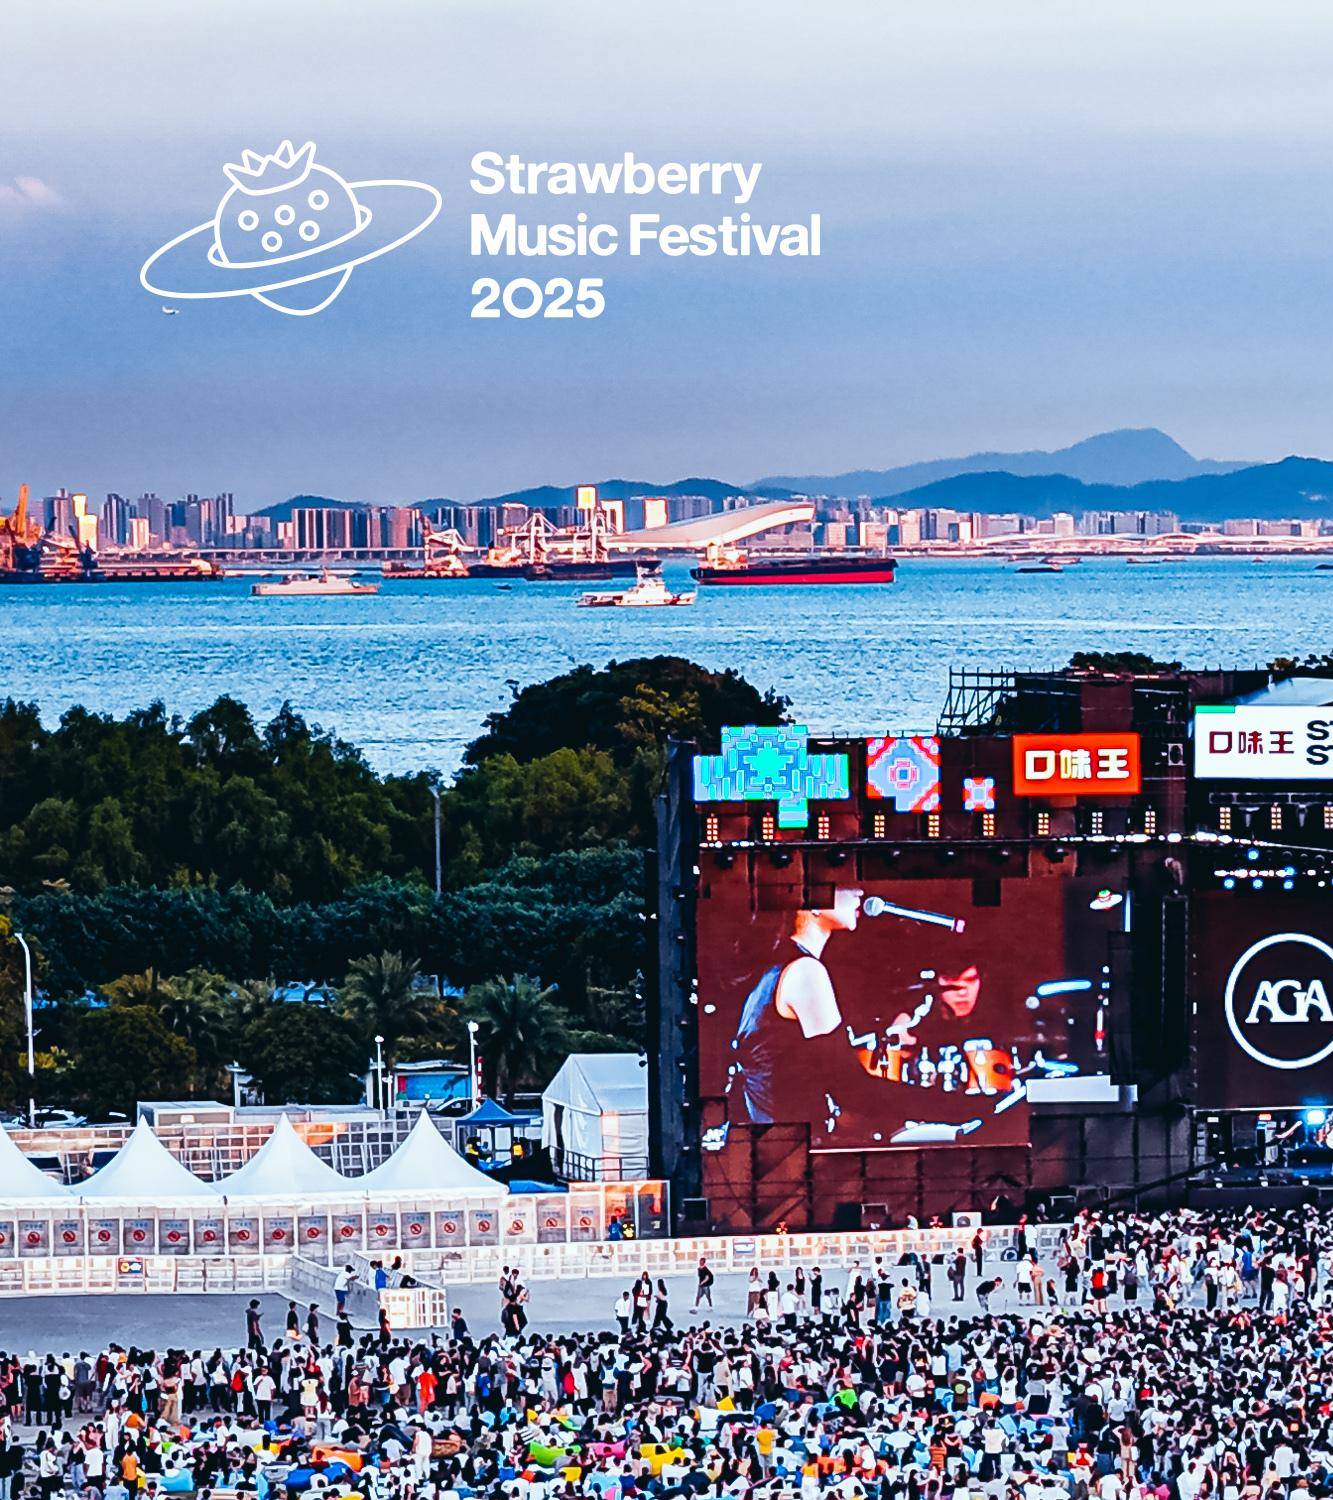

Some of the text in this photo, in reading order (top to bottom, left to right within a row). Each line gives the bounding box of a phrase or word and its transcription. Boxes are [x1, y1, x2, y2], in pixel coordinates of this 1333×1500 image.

[1209, 730, 1295, 754] 口味王
[1025, 748, 1130, 780] 口味王
